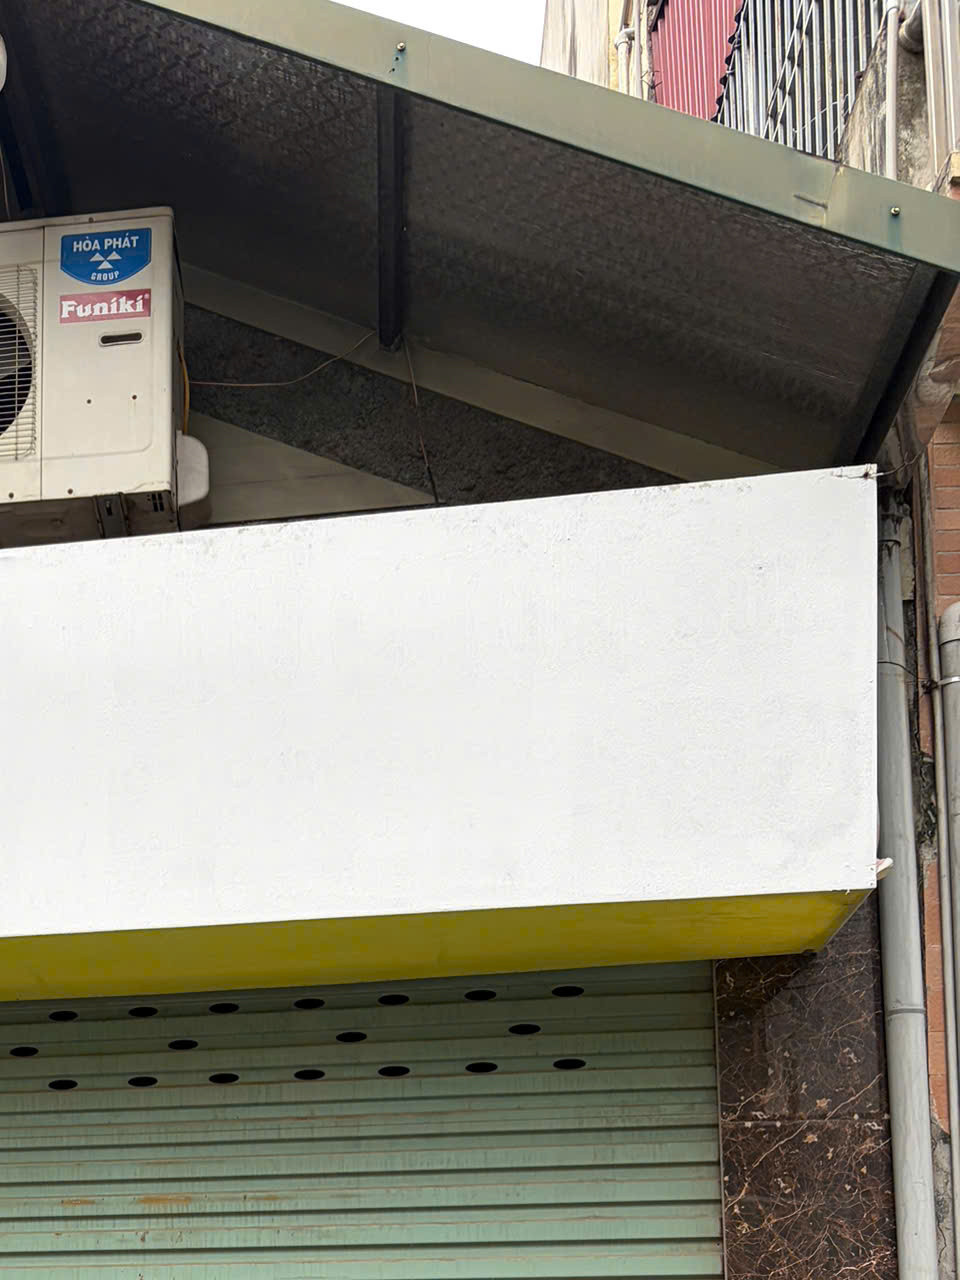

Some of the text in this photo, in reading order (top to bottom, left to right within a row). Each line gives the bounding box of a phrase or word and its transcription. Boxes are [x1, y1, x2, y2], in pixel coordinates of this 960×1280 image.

[73, 233, 139, 252] HÒA PHÁT
[90, 271, 120, 281] GROUP
